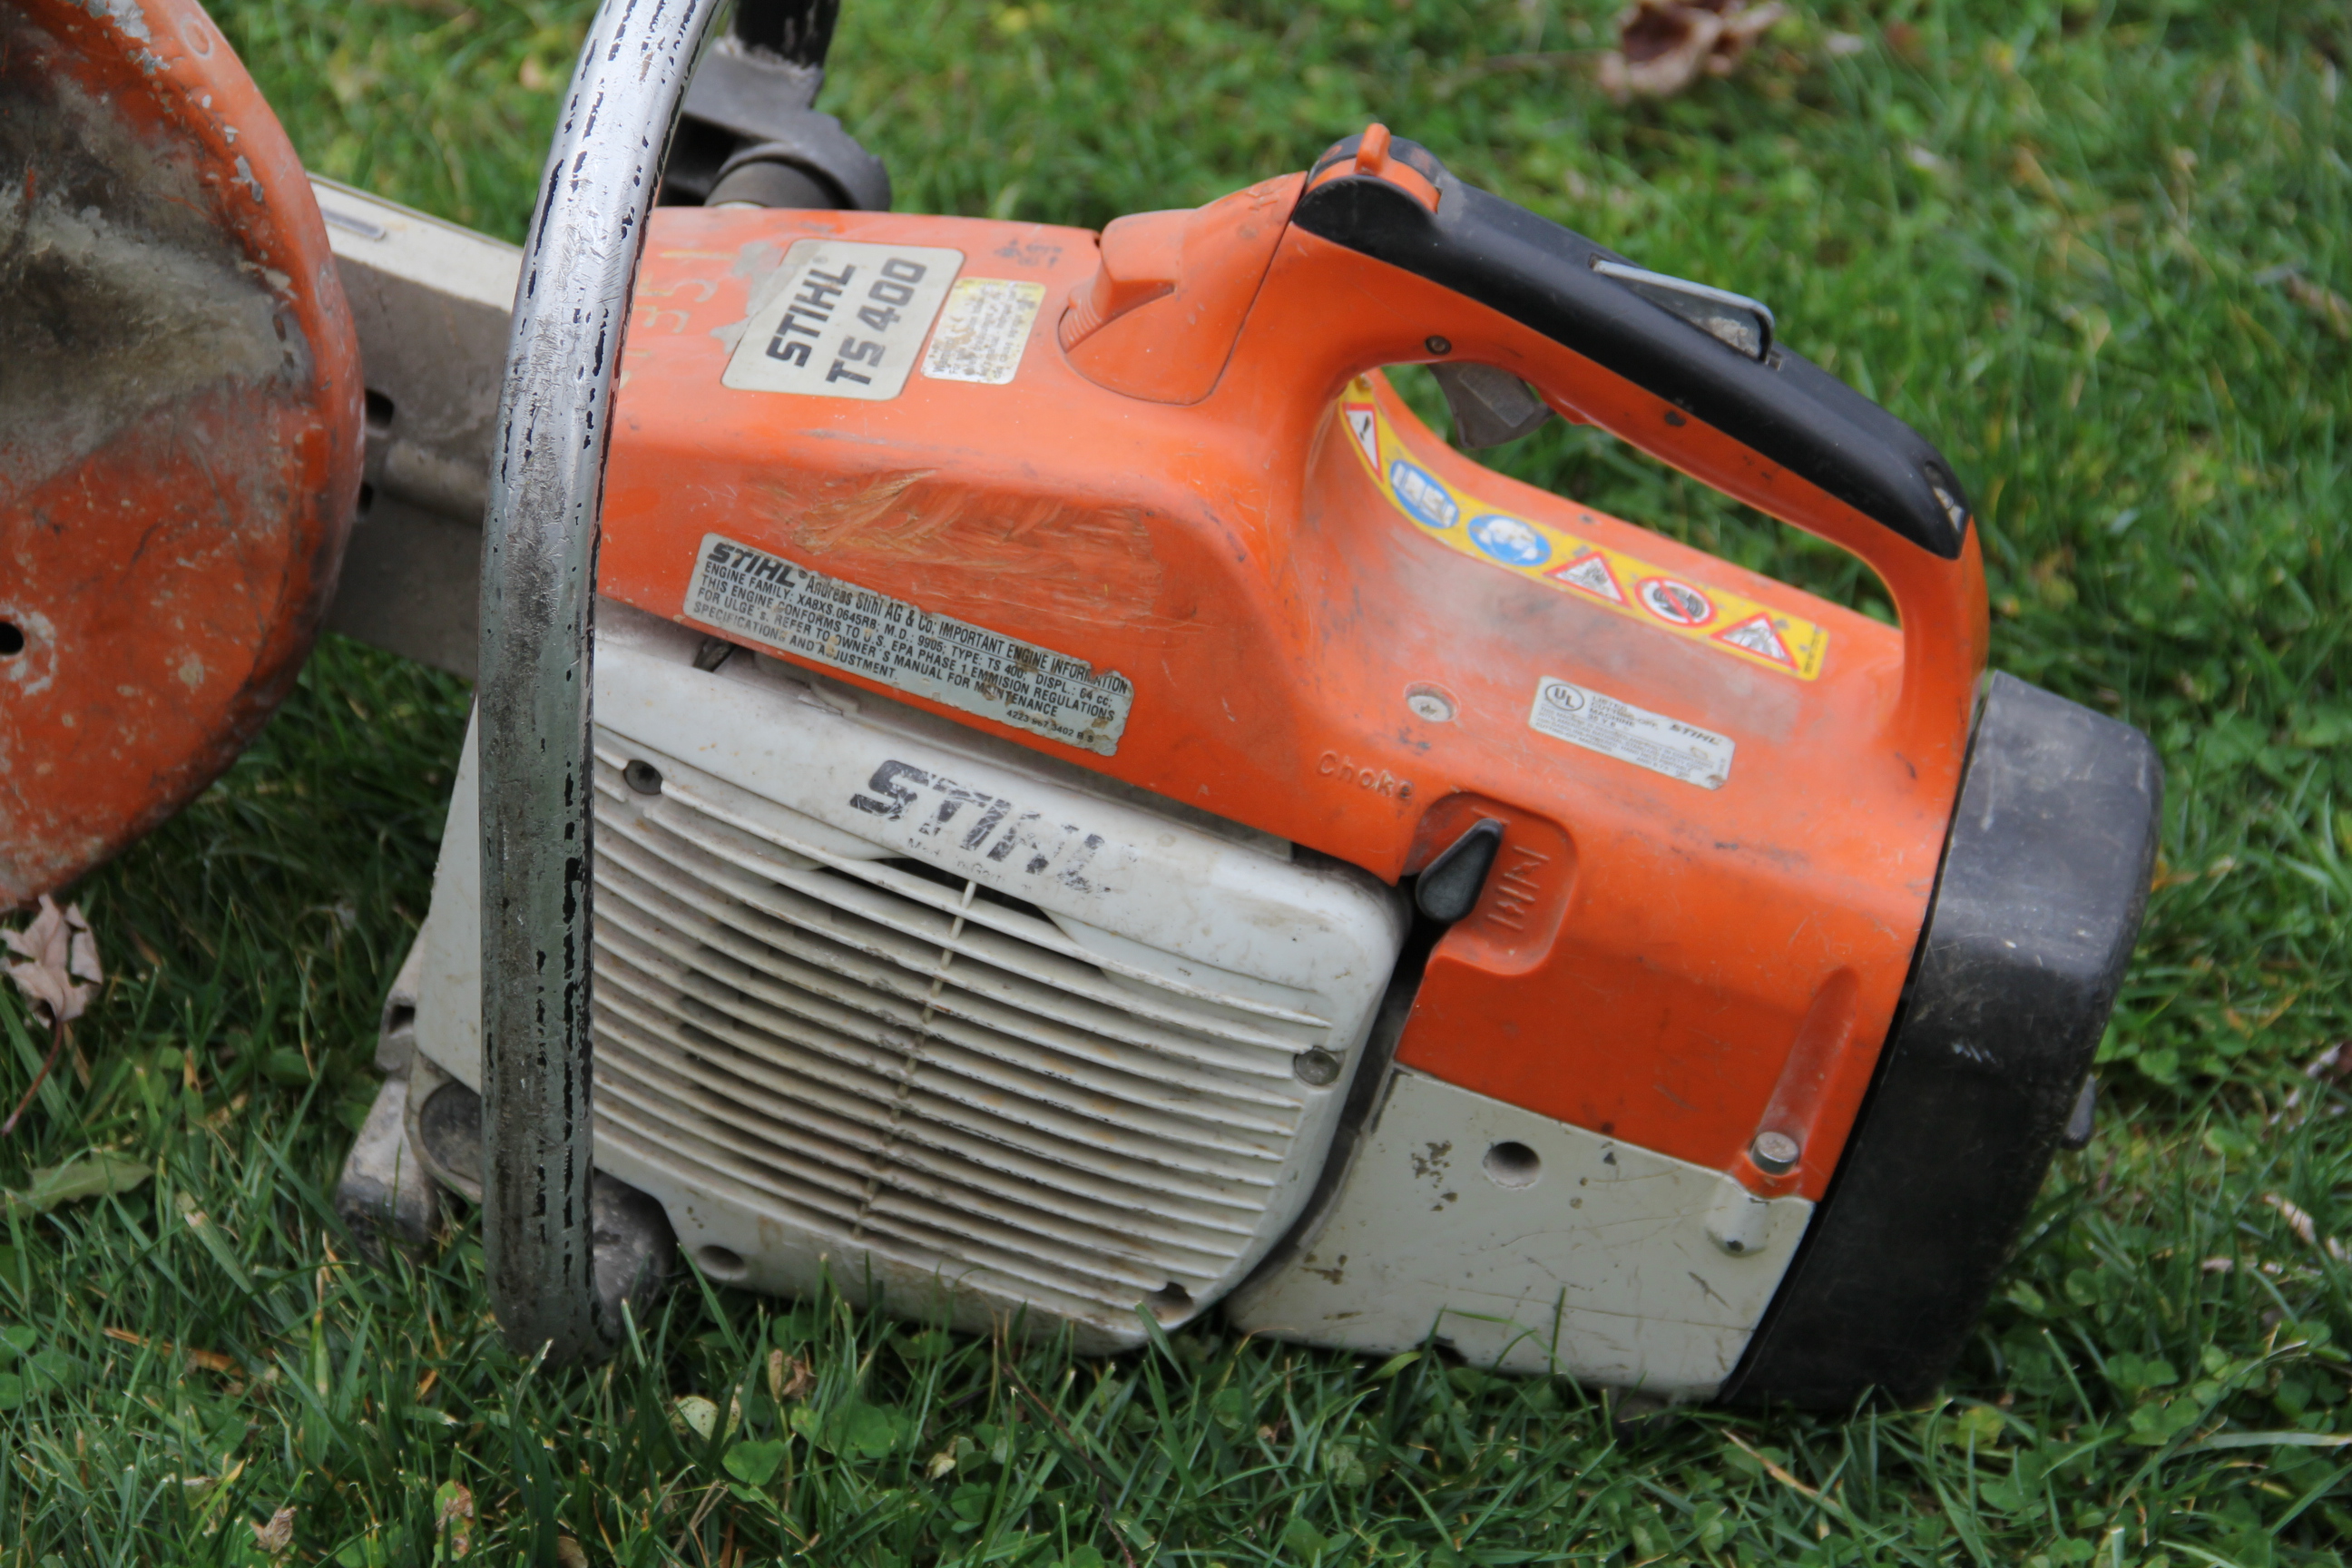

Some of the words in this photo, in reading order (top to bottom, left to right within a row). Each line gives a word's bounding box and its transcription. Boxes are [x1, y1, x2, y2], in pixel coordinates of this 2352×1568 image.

[766, 263, 858, 368] STIHL
[826, 336, 887, 386] TS
[857, 257, 927, 334] 400
[698, 588, 720, 603] FOR
[775, 614, 812, 634] REFER
[816, 629, 830, 641] TO
[895, 655, 944, 679] MANUAL
[948, 672, 970, 688] FOR
[702, 575, 729, 593] THIS
[731, 586, 774, 607] ENGINE
[778, 601, 842, 632] CONFORMS
[846, 624, 860, 638] TO
[892, 641, 914, 656] EPA
[918, 650, 956, 670] PHASE
[962, 664, 966, 672] 1
[972, 667, 1029, 693] EMMISION
[1034, 686, 1114, 721] REGULATIONS
[705, 562, 746, 583] ENGINE
[750, 577, 795, 601] FAMILY:
[952, 646, 983, 664] TYPE:
[988, 658, 1001, 671] TS
[1005, 664, 1027, 680] 400;
[1081, 688, 1093, 700] 64
[707, 542, 796, 588] STIHL
[806, 575, 854, 604] Andreas
[856, 592, 884, 615] Stihl
[886, 602, 904, 622] AG
[906, 610, 916, 626] &
[940, 622, 1004, 654] IMPORTANT
[1008, 643, 1048, 668] ENGINE
[1052, 658, 1128, 693] INFORATION
[790, 634, 815, 651] AND
[818, 644, 899, 679] AJUSTMENT.
[1007, 709, 1029, 721] 4223
[1554, 687, 1575, 708] UL
[1590, 707, 1635, 727] MACHINE
[1670, 723, 1721, 745] STIHL
[1317, 750, 1415, 799] Choke
